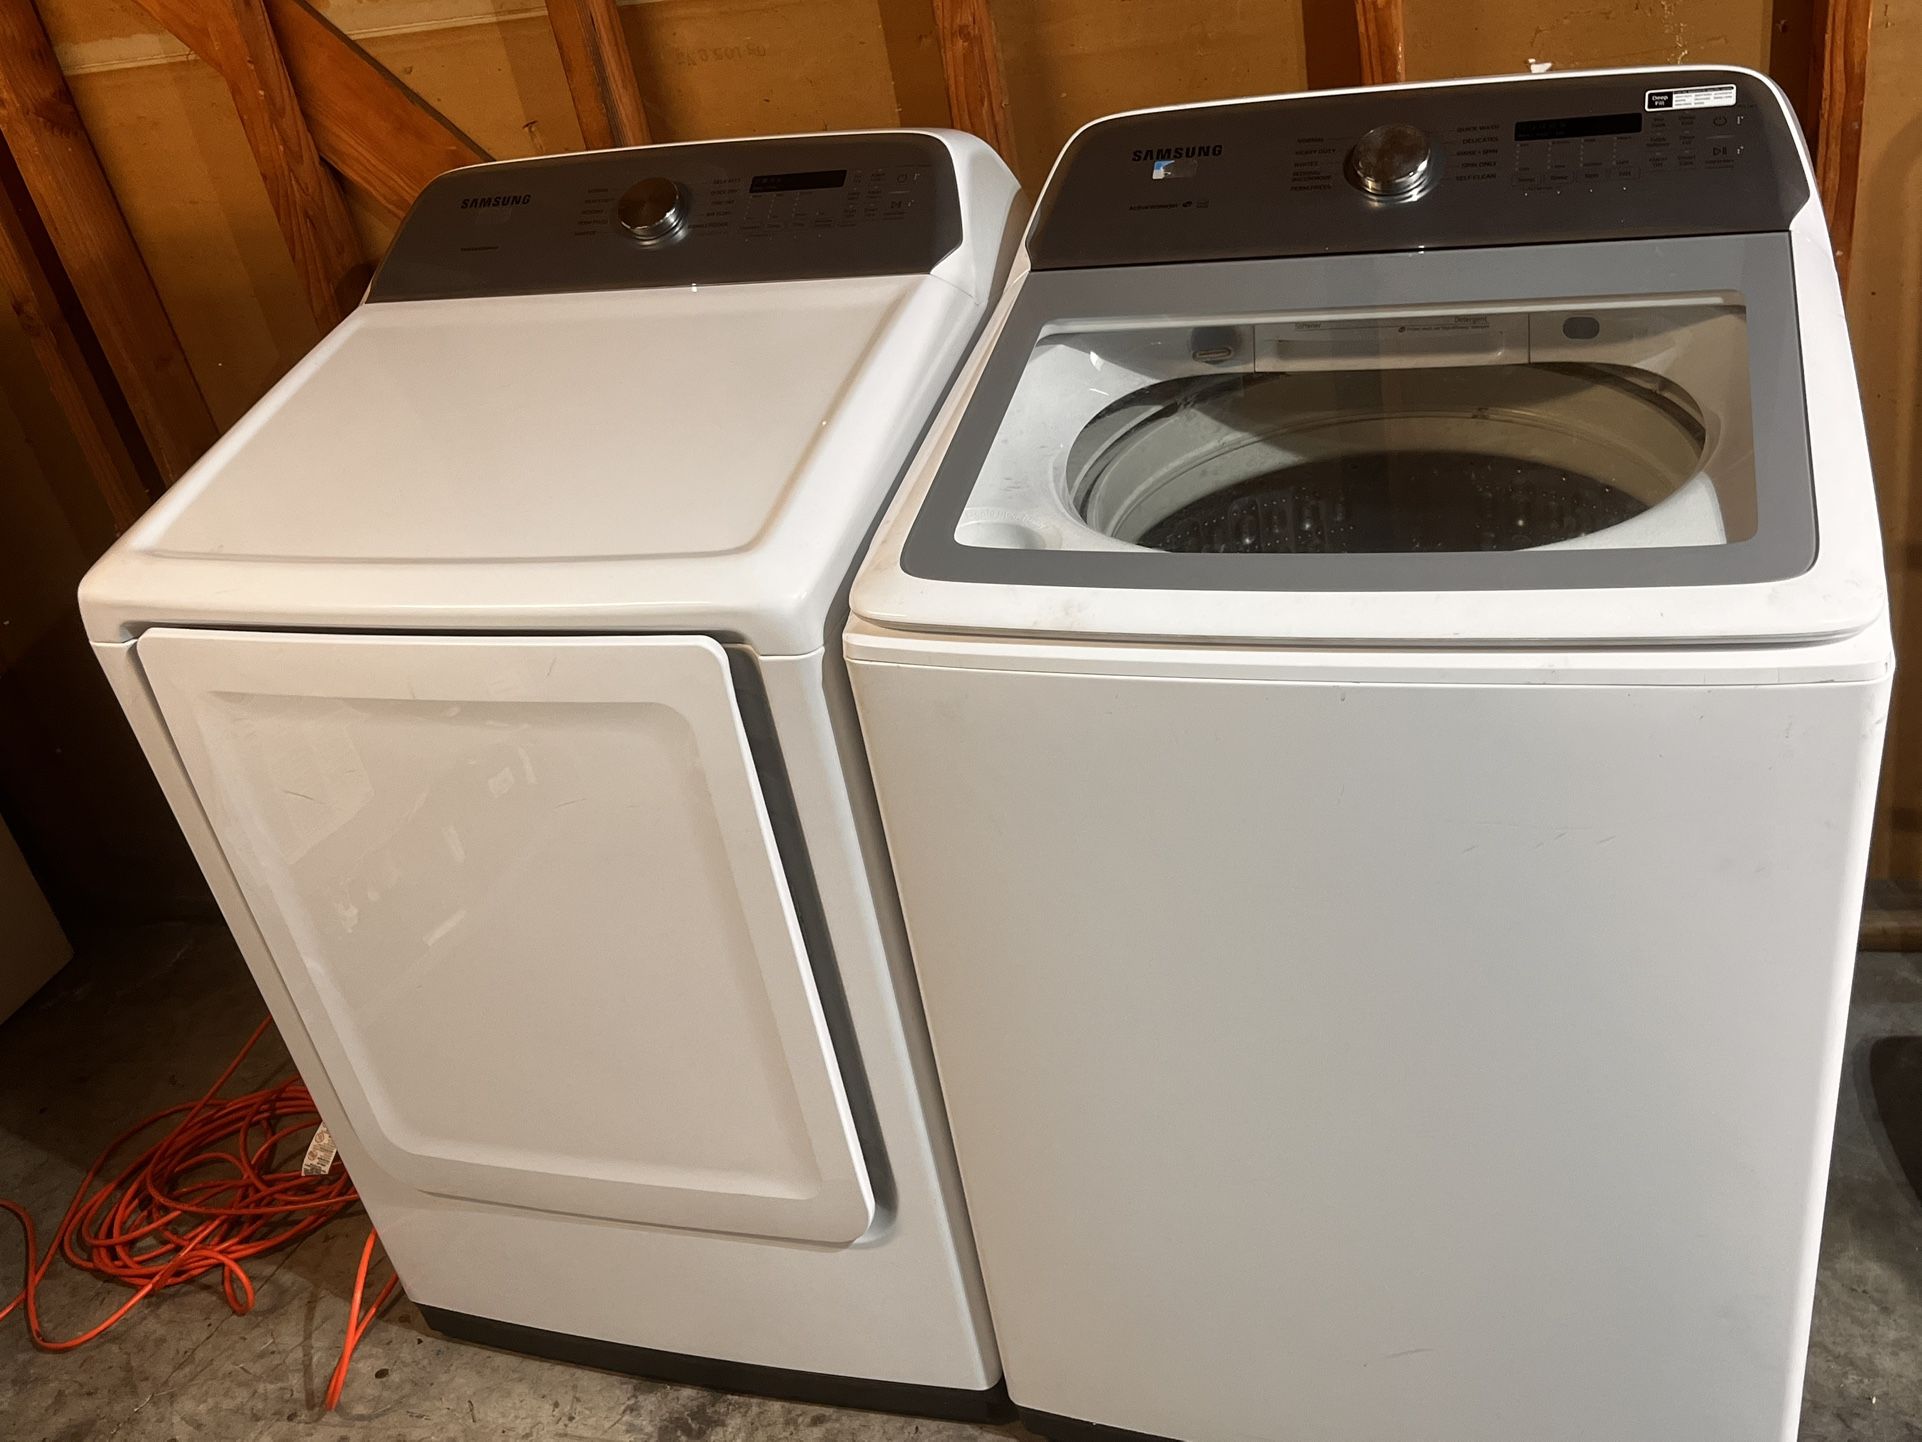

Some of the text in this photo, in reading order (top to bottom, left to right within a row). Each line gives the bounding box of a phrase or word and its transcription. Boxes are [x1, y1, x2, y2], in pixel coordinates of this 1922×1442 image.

[1652, 94, 1669, 102] Deep
[1131, 144, 1223, 162] SAMSUNG
[460, 193, 531, 209] SAMSUNG
